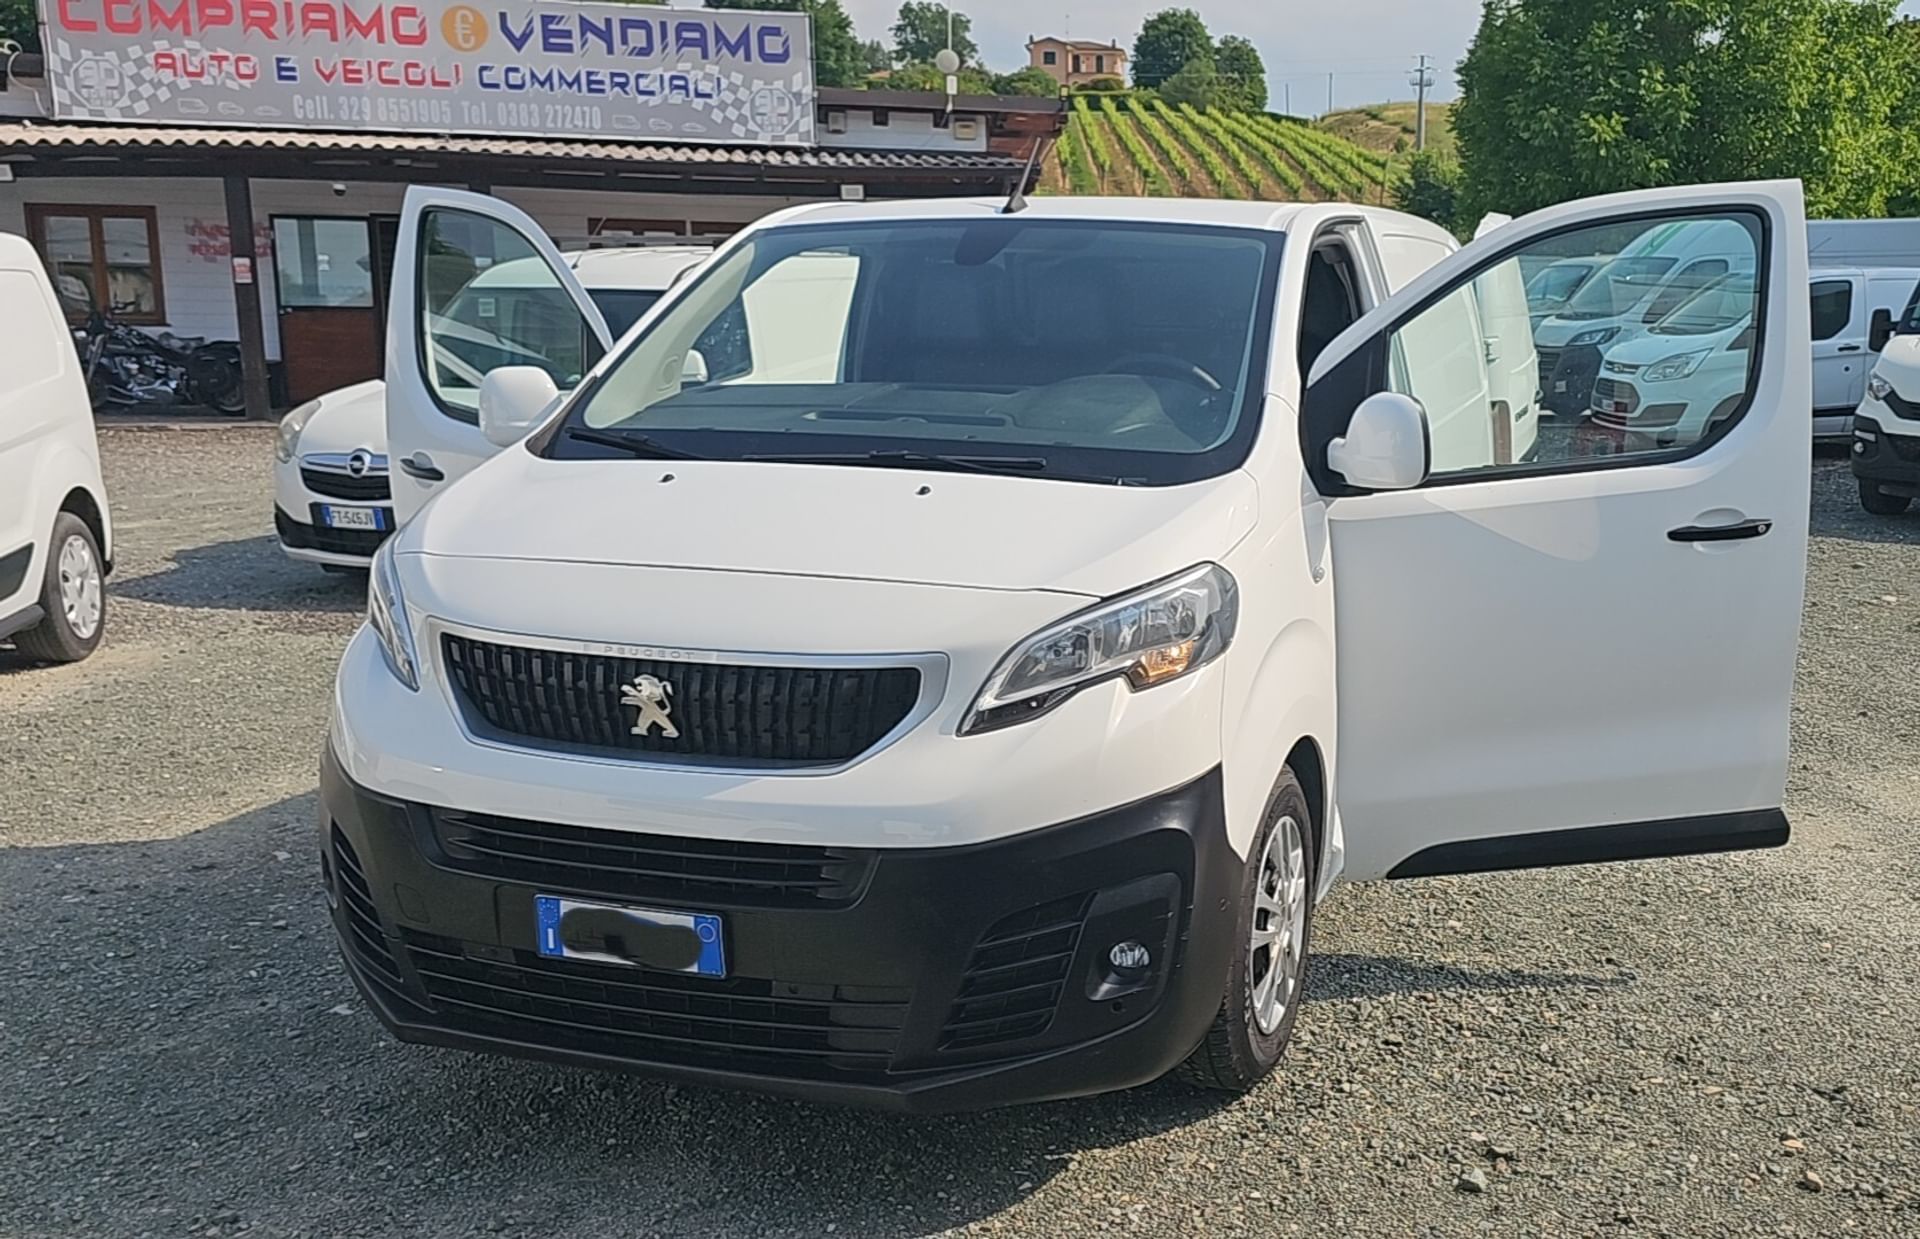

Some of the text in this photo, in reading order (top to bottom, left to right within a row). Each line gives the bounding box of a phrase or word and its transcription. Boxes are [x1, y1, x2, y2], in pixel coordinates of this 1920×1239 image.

[58, 0, 427, 46] COMPRIAMO
[498, 9, 790, 64] VENDIAMO
[153, 52, 722, 99] AUTO E VEICOLI COMMERCIALI
[293, 94, 601, 130] Cell. 329 8551905 Tel. 0383 272470
[603, 646, 695, 660] PEUGEOT
